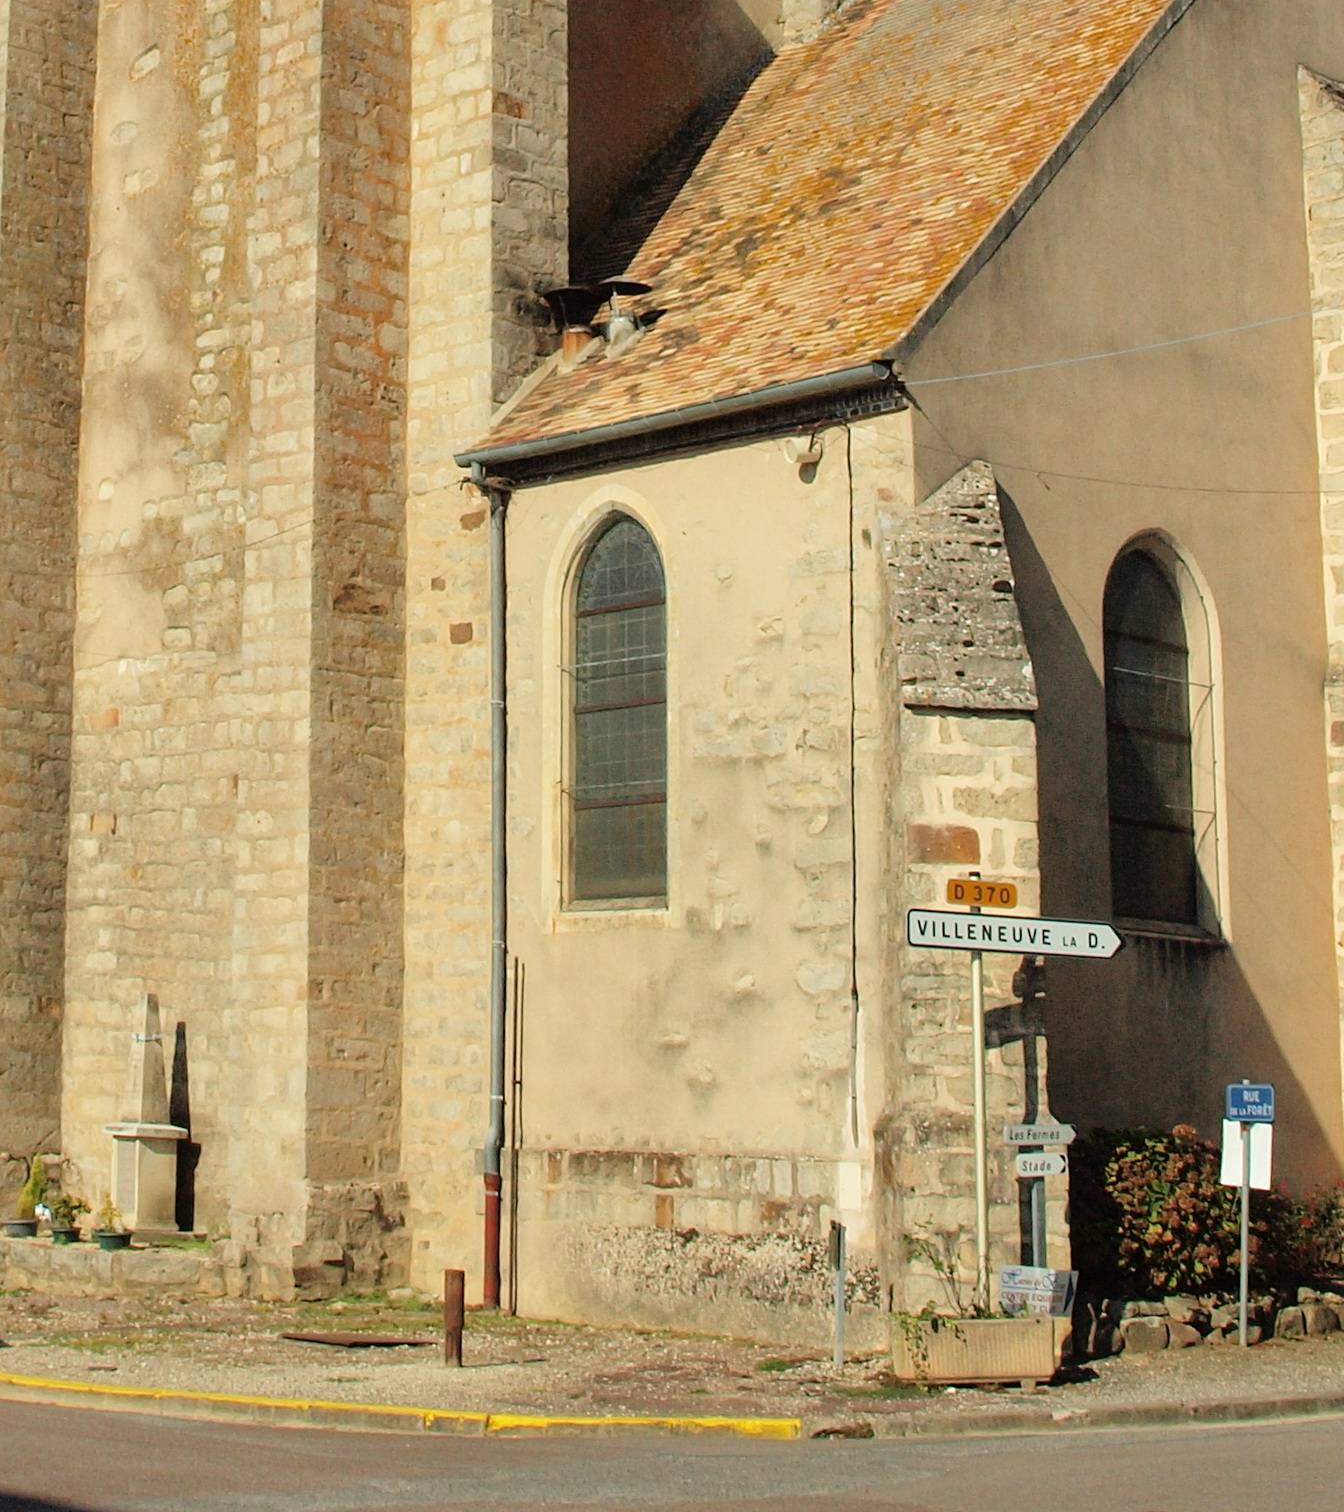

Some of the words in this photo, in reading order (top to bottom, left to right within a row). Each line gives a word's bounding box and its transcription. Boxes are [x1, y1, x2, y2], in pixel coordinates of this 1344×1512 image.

[955, 884, 964, 899] D
[973, 885, 1010, 904] 370
[917, 919, 1052, 946] VILLENEUVE
[1062, 936, 1077, 947] LA
[1088, 932, 1106, 949] D.
[1243, 1090, 1260, 1102] RUE
[1247, 1103, 1273, 1116] FORÊT
[1009, 1129, 1024, 1140] Les
[1026, 1128, 1060, 1140] Fermes
[1022, 1159, 1052, 1172] Stade
